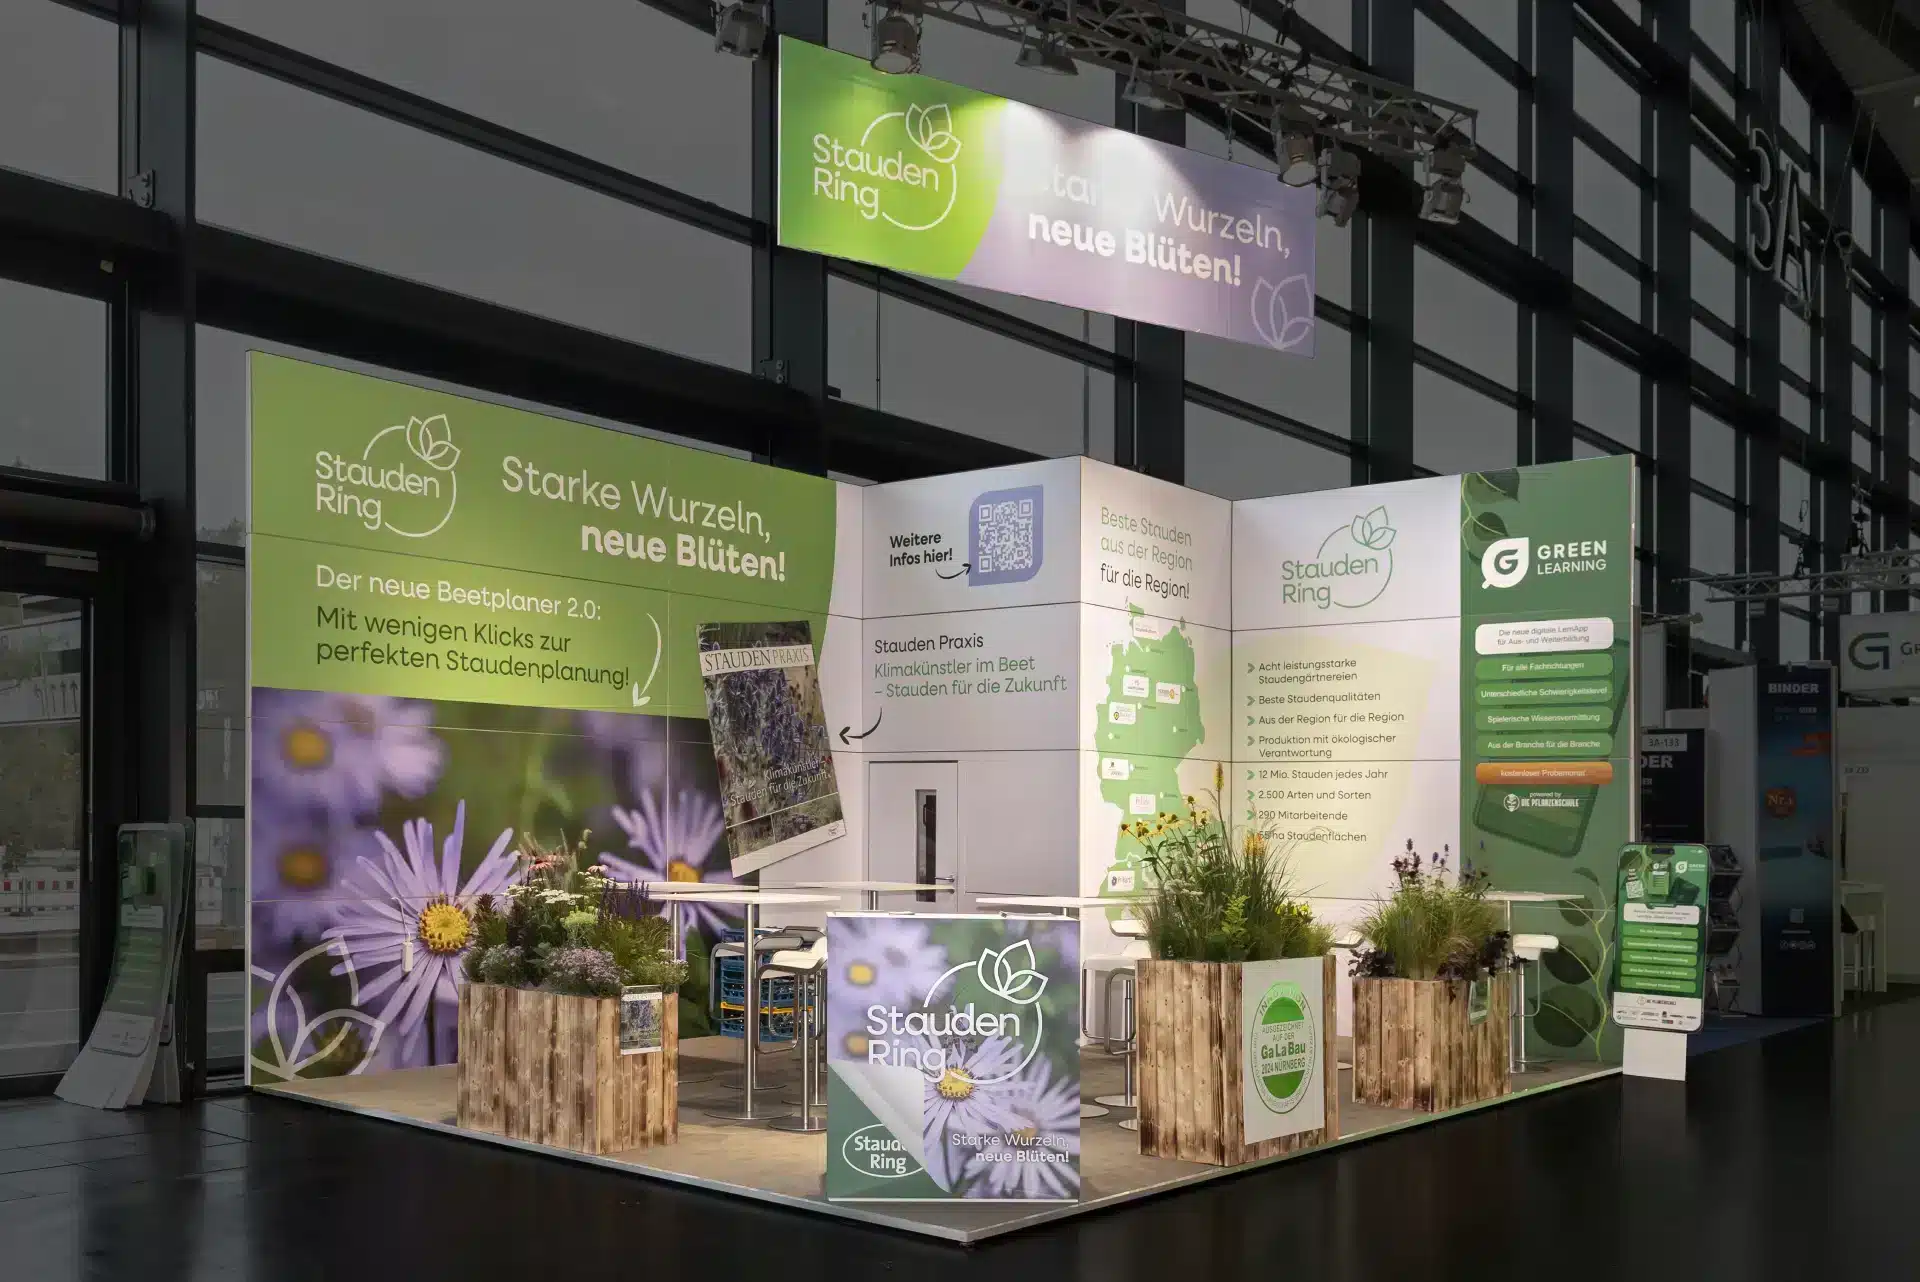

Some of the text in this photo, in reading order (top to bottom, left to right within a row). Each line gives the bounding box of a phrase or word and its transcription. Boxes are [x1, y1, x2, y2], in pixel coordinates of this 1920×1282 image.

[813, 133, 940, 191] Stauden
[814, 168, 880, 219] Ring
[1153, 192, 1291, 260] Wurzeln,
[1029, 212, 1241, 287] neue Blüten!
[315, 450, 440, 498] Stauden
[316, 483, 382, 529] Ring
[501, 455, 771, 543] Starke Wurzeln,
[1101, 506, 1192, 546] Beste Stauden
[889, 531, 942, 548] Weitere
[581, 524, 786, 581] neue Blüten!
[889, 548, 953, 567] Infos hier!
[1101, 537, 1193, 571] aus der Region
[1537, 540, 1607, 560] GREEN
[1281, 553, 1378, 581] Stauden
[1537, 559, 1607, 575] LEARNING
[1100, 563, 1190, 599] für die Region!
[316, 564, 601, 621] Der neue Beetplaner 2.0:
[1283, 583, 1331, 609] Ring
[316, 606, 571, 653] Mit wenigen Klicks zur
[1531, 627, 1556, 635] digitale
[875, 633, 984, 654] Stauden Praxis
[1497, 637, 1506, 645] für
[1541, 635, 1589, 645] Weiterbildung
[316, 641, 629, 690] perfekten Staudenplanung!
[875, 655, 1035, 679] Klimakünstler im Beet
[1259, 658, 1357, 671] Acht leistungsstarke
[1502, 664, 1514, 672] Für
[1515, 663, 1528, 671] alle
[886, 680, 948, 698] Stauden
[952, 679, 973, 695] für
[977, 678, 1000, 694] die
[1005, 675, 1067, 693] Zukunft
[1259, 672, 1357, 685] Staudengärtnereien
[1481, 689, 1538, 698] Unterschiedliche
[1768, 683, 1819, 694] BINDER
[1259, 692, 1381, 705] Beste Staudenqualitäten
[1259, 712, 1404, 725] Aus der Region für die Region
[1487, 715, 1529, 724] Spielerische
[1259, 734, 1396, 745] Produktion mit ökologischer
[1487, 741, 1501, 749] Aus
[1545, 740, 1555, 748] für
[1259, 748, 1332, 759] Verantwortung
[1259, 770, 1388, 780] 12 Mio. Stauden jedes Jahr
[730, 787, 767, 806] Stauden
[769, 782, 782, 797] für
[783, 777, 797, 790] die
[1258, 791, 1371, 800] 2.500 Arten und Sorten
[1553, 791, 1562, 799] by
[1258, 811, 1348, 820] 290 Mitarbeitende
[1272, 831, 1284, 840] ha
[1287, 831, 1367, 842] Staudenflächen
[867, 1003, 1020, 1037] Stauden
[868, 1040, 946, 1084] Ring
[1274, 1057, 1306, 1072] NÜRNBERG
[952, 1133, 1069, 1149] Starke Wurzeln,
[870, 1154, 906, 1174] Ring
[975, 1150, 1069, 1163] neue Blüten!
